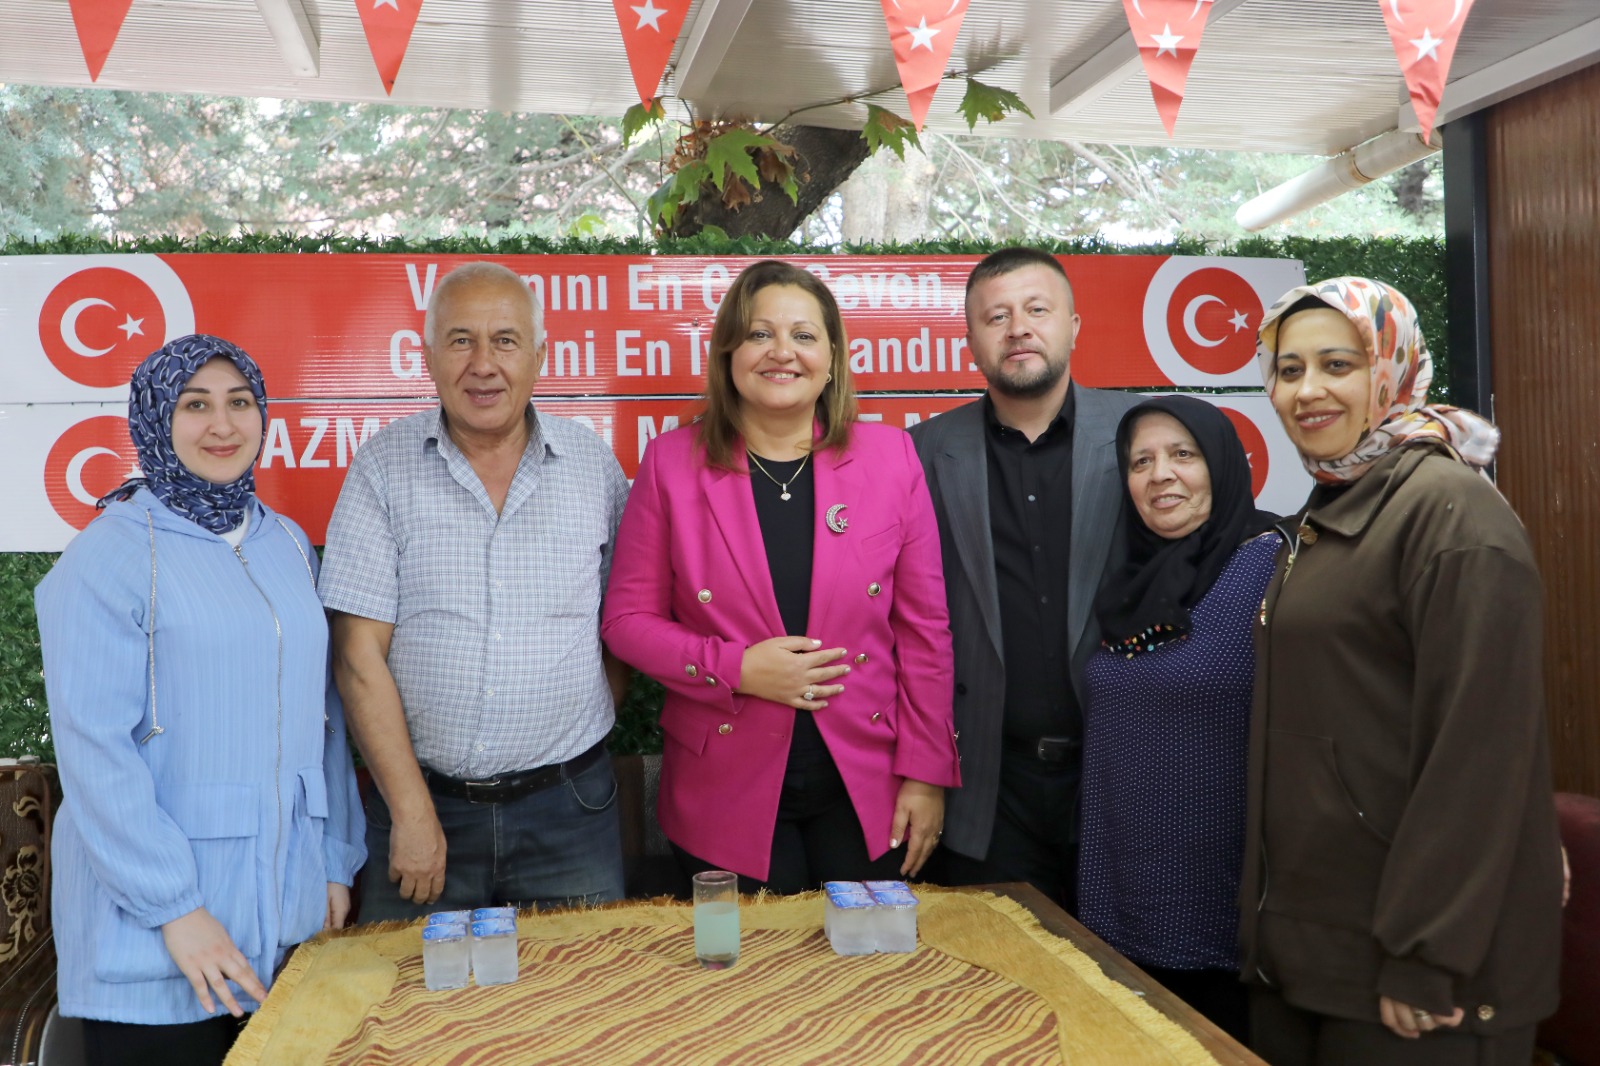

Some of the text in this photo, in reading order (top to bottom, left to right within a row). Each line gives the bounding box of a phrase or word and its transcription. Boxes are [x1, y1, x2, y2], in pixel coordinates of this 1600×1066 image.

[405, 263, 608, 311] Vnını
[628, 264, 683, 311] En
[615, 329, 671, 376] En
[849, 327, 978, 374] andır.
